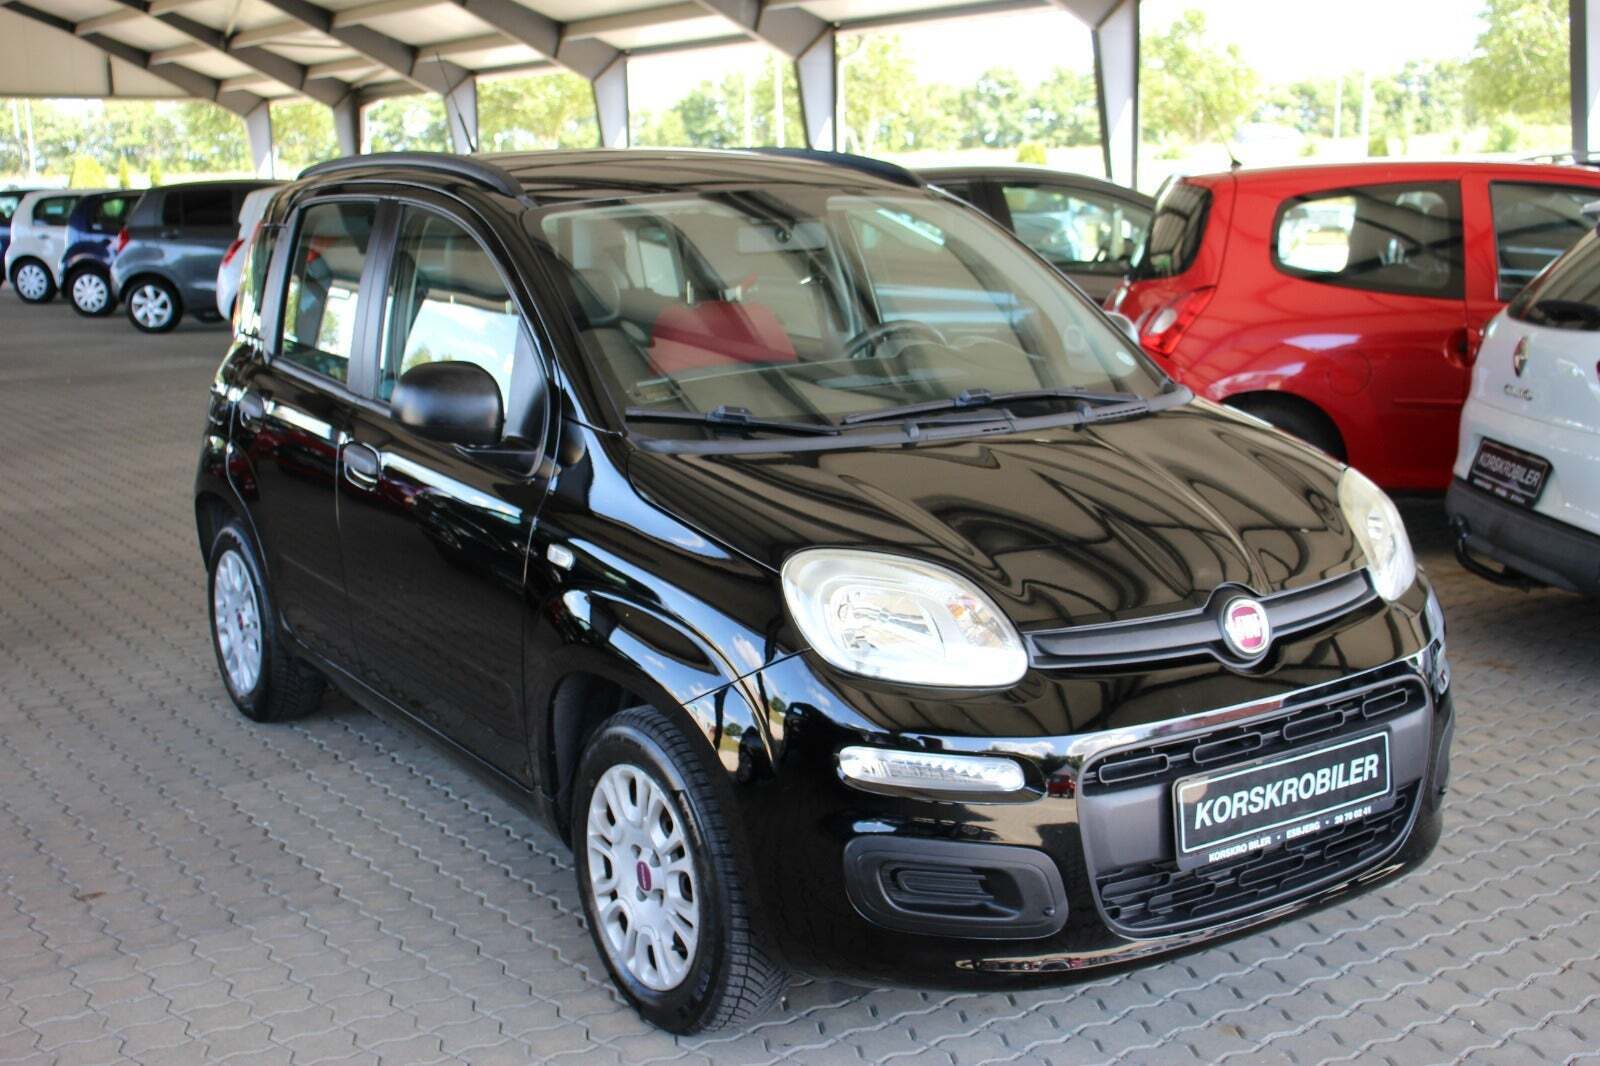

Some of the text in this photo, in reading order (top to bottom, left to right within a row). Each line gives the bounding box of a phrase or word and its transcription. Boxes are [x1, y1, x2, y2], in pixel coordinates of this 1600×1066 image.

[1195, 754, 1379, 830] KORSKROBILER
[1209, 843, 1248, 863] KORSKRO
[1248, 836, 1272, 851] BILER
